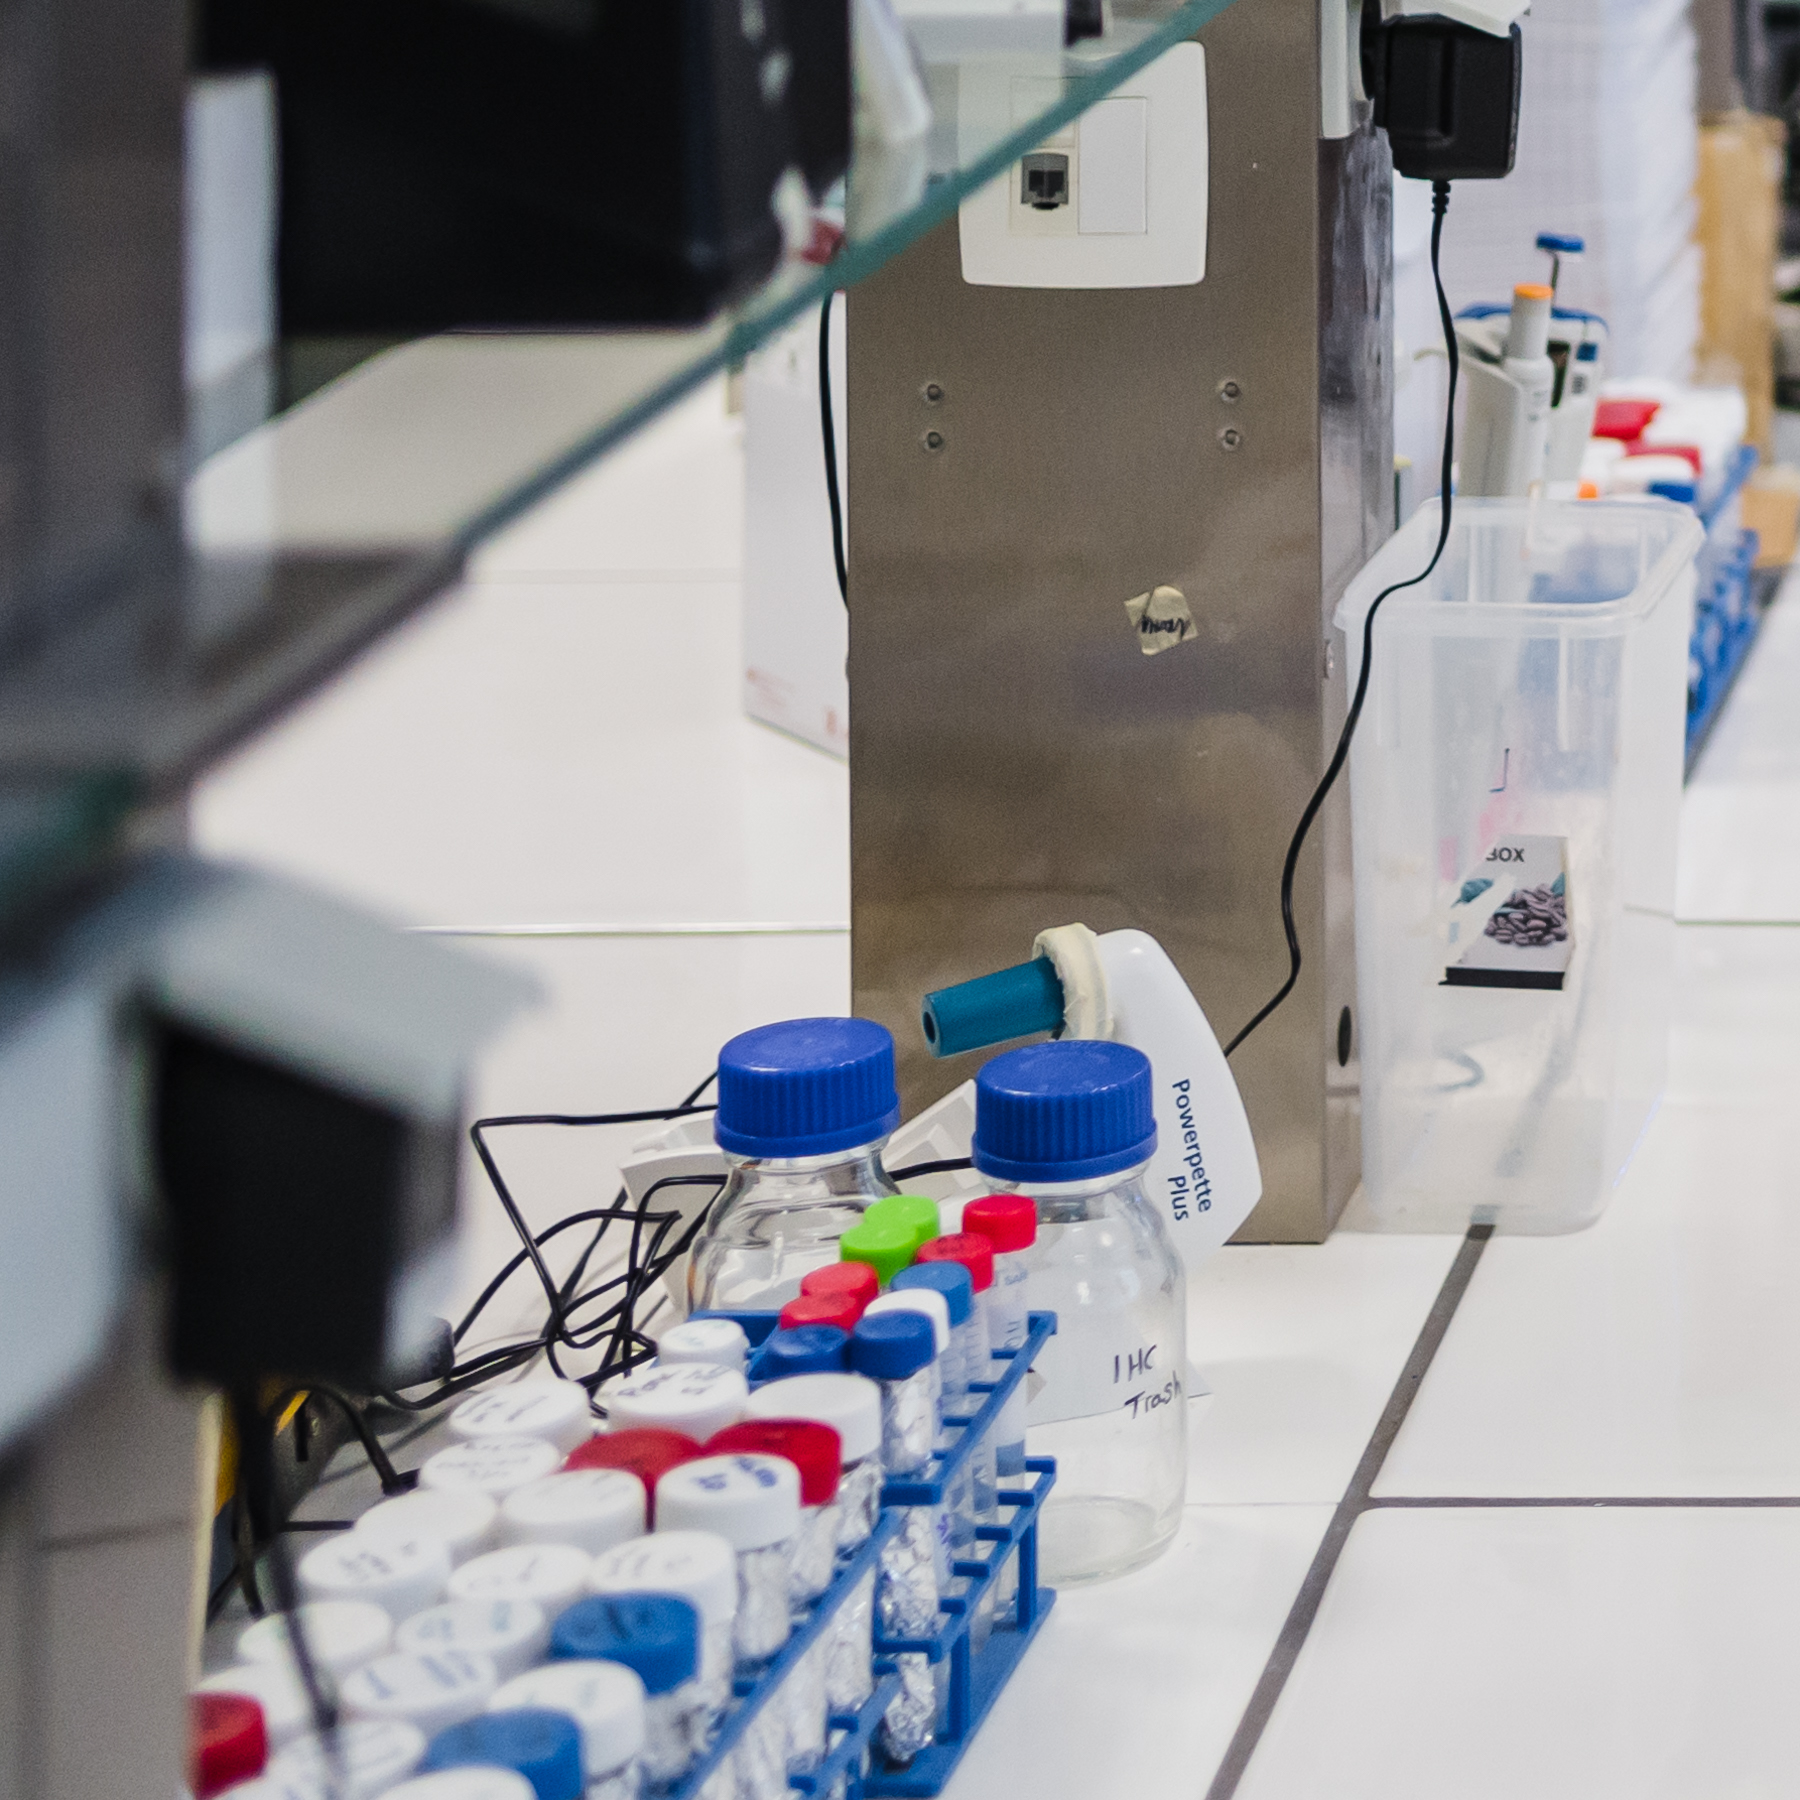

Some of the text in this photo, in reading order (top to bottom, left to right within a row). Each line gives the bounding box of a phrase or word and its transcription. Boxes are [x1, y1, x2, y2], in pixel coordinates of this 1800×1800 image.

[1172, 1078, 1213, 1213] Powerpette
[1167, 1175, 1190, 1222] Plus
[1124, 1370, 1183, 1420] Trash
